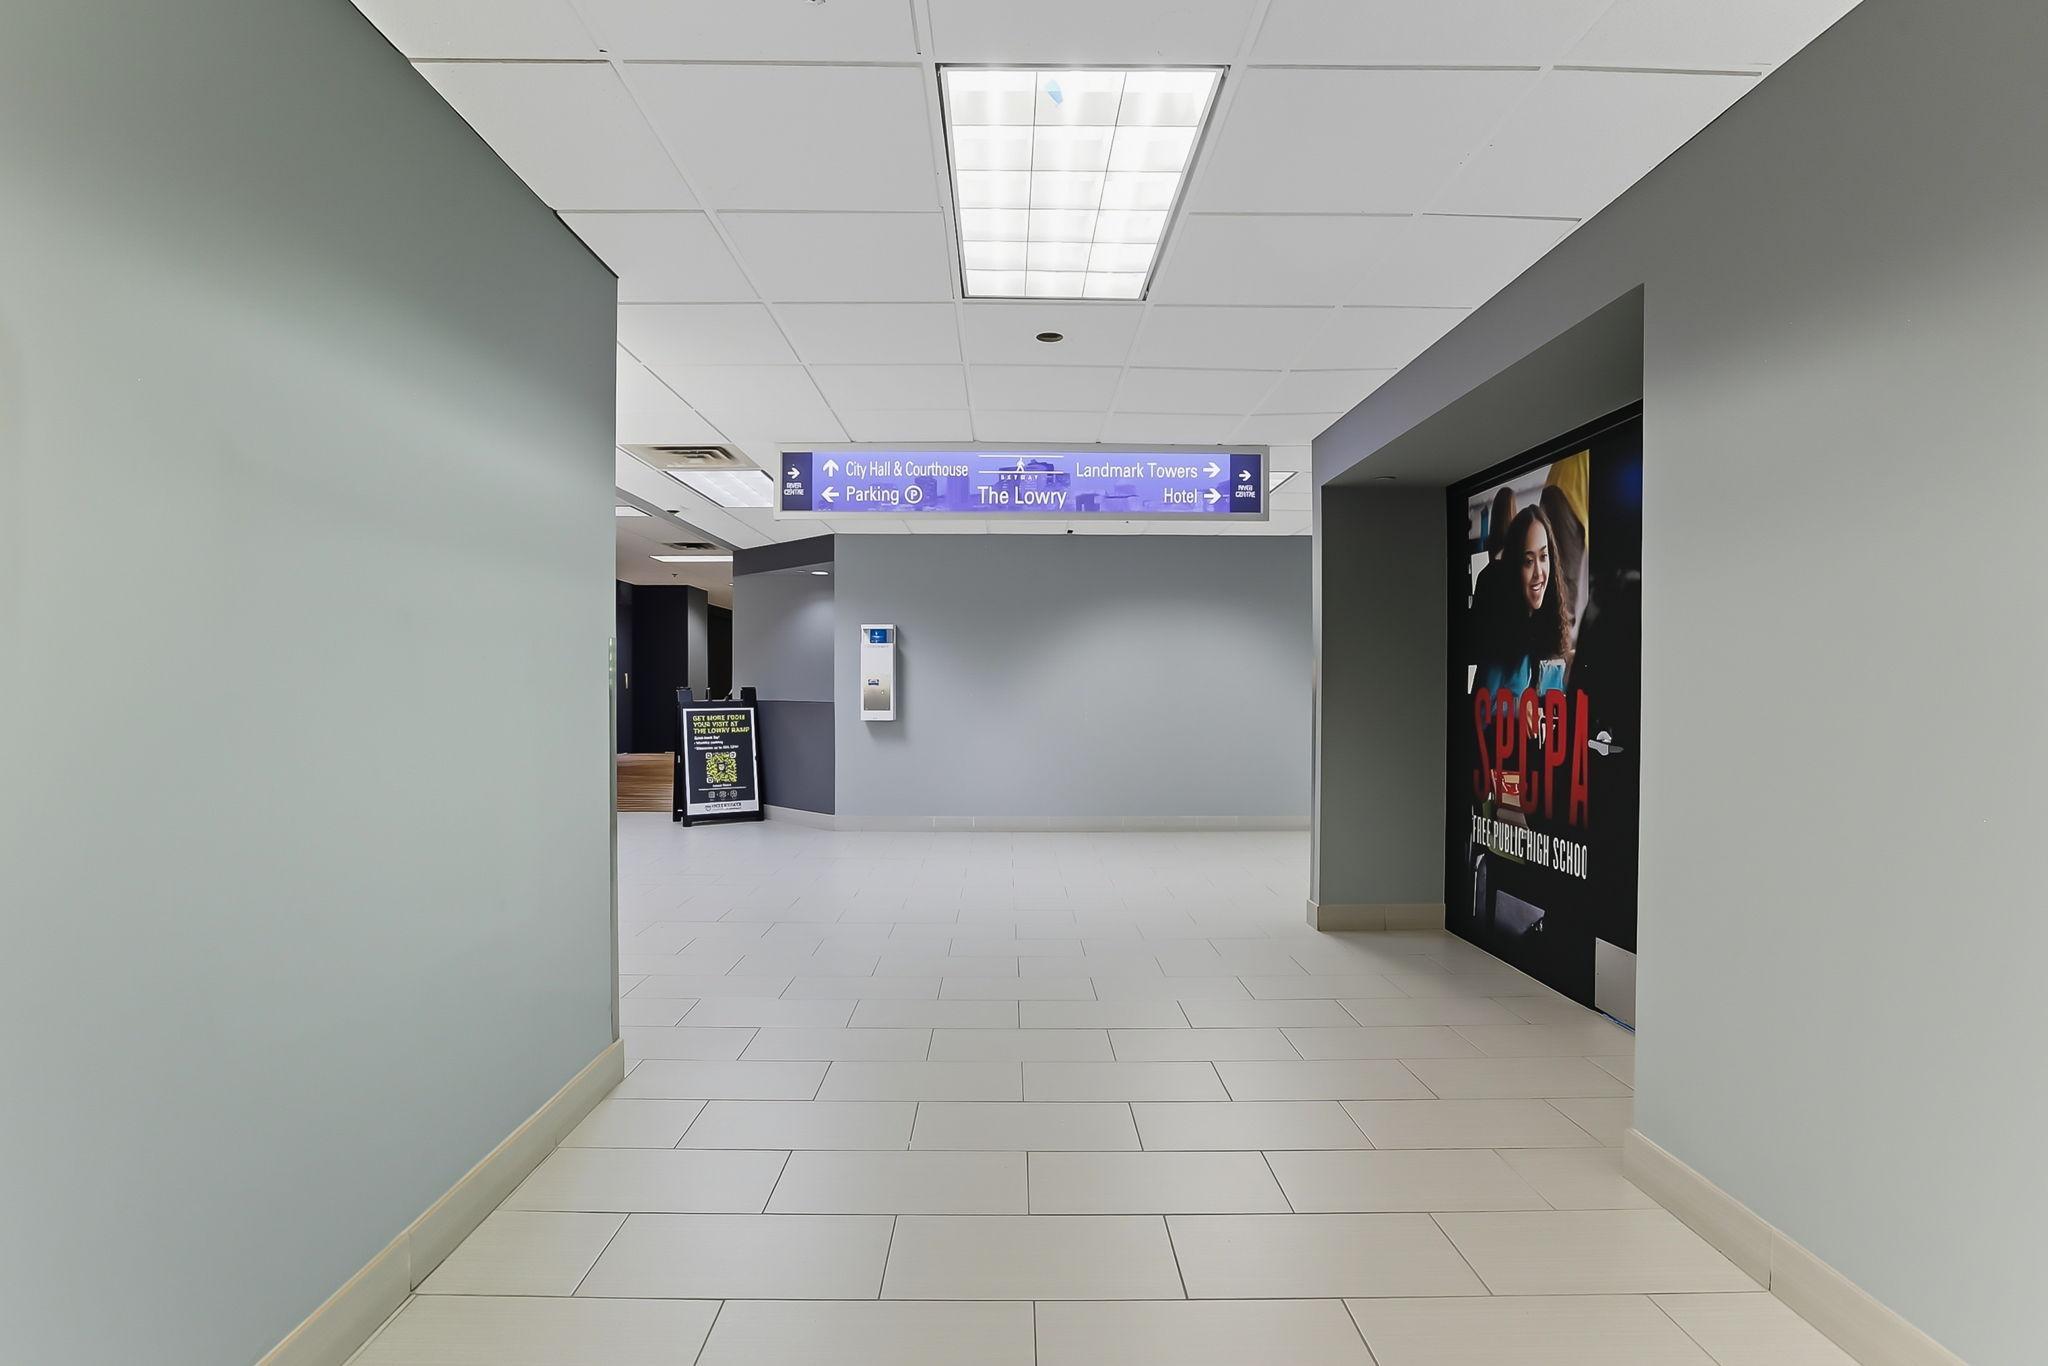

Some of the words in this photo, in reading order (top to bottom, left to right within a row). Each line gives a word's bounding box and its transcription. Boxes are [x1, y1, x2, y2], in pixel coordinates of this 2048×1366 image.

[846, 461, 867, 479] City
[870, 461, 891, 477] Hall
[893, 461, 902, 477] &
[905, 461, 968, 477] Courthouse
[1076, 463, 1144, 478] Landmark
[1149, 463, 1198, 478] Towers
[846, 486, 899, 505] Parking
[977, 486, 1009, 504] The
[1015, 486, 1066, 509] Lowry
[1164, 488, 1198, 504] Hotel
[1473, 687, 1589, 828] SPCPA
[1472, 815, 1490, 846] FREE
[1493, 820, 1524, 858] PUBLIC
[1526, 829, 1549, 867] HIGH
